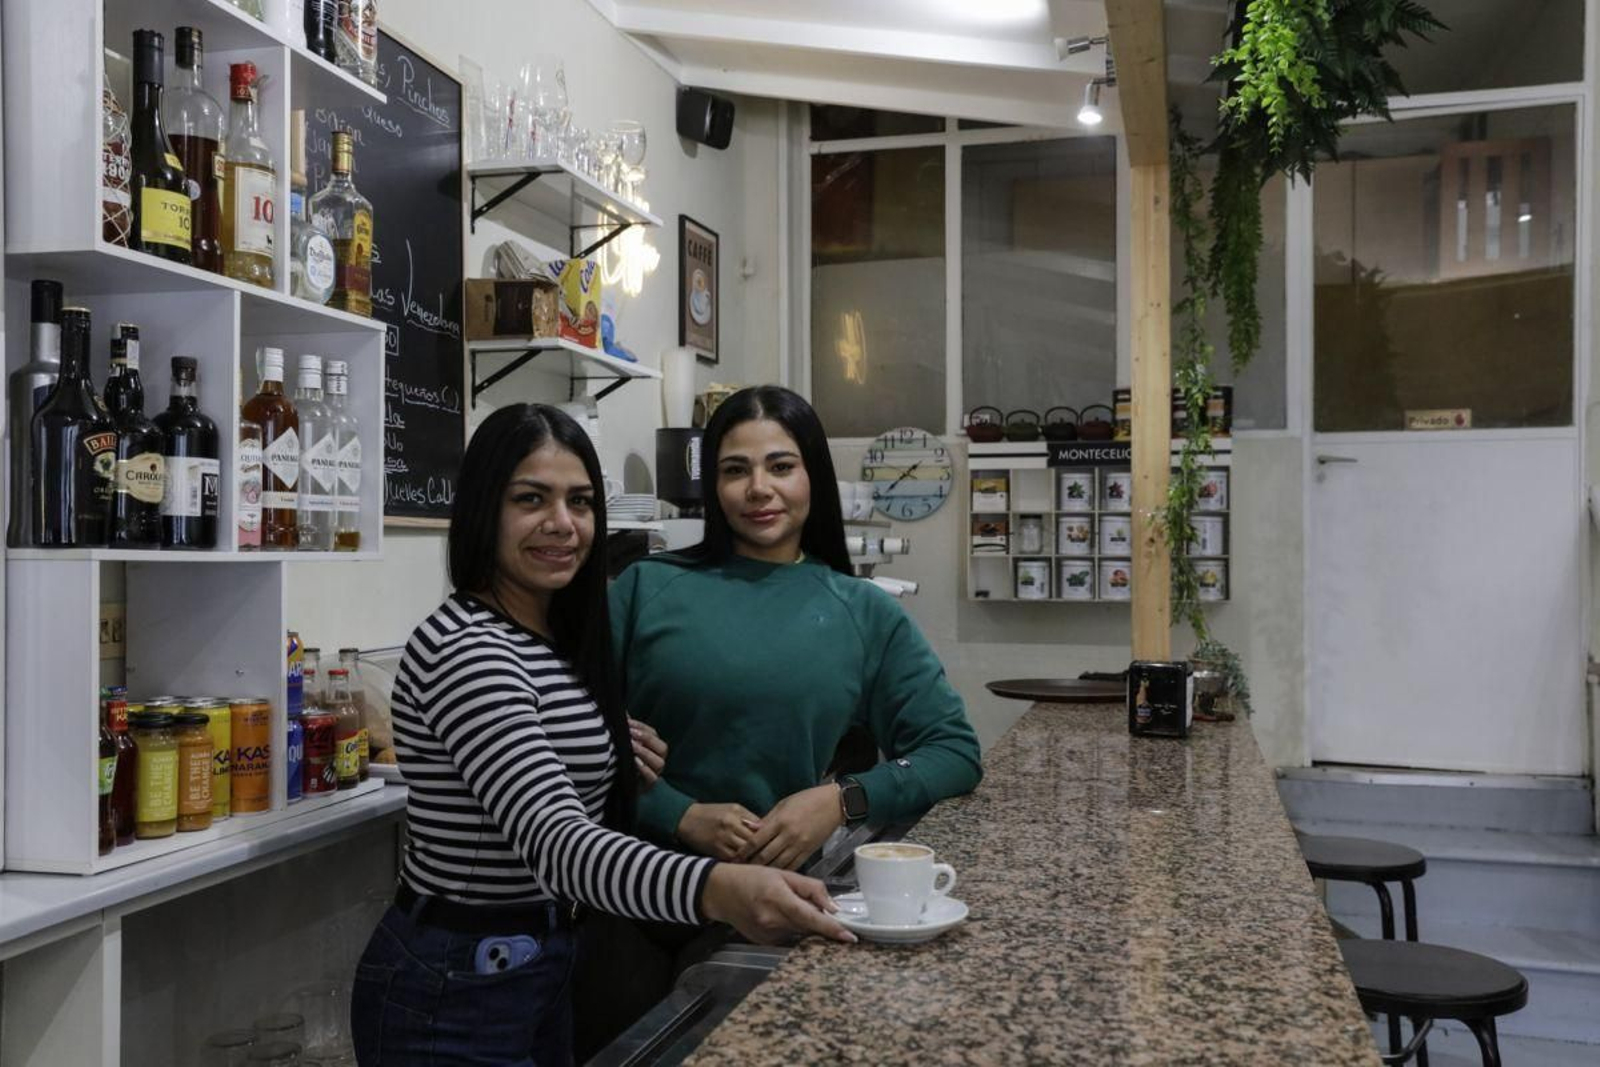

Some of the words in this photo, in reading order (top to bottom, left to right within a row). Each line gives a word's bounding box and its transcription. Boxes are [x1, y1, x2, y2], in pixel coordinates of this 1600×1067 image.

[1408, 415, 1449, 427] Privado
[900, 429, 914, 445] 12
[868, 448, 885, 463] 10
[901, 502, 913, 517] 6
[190, 760, 202, 782] THE
